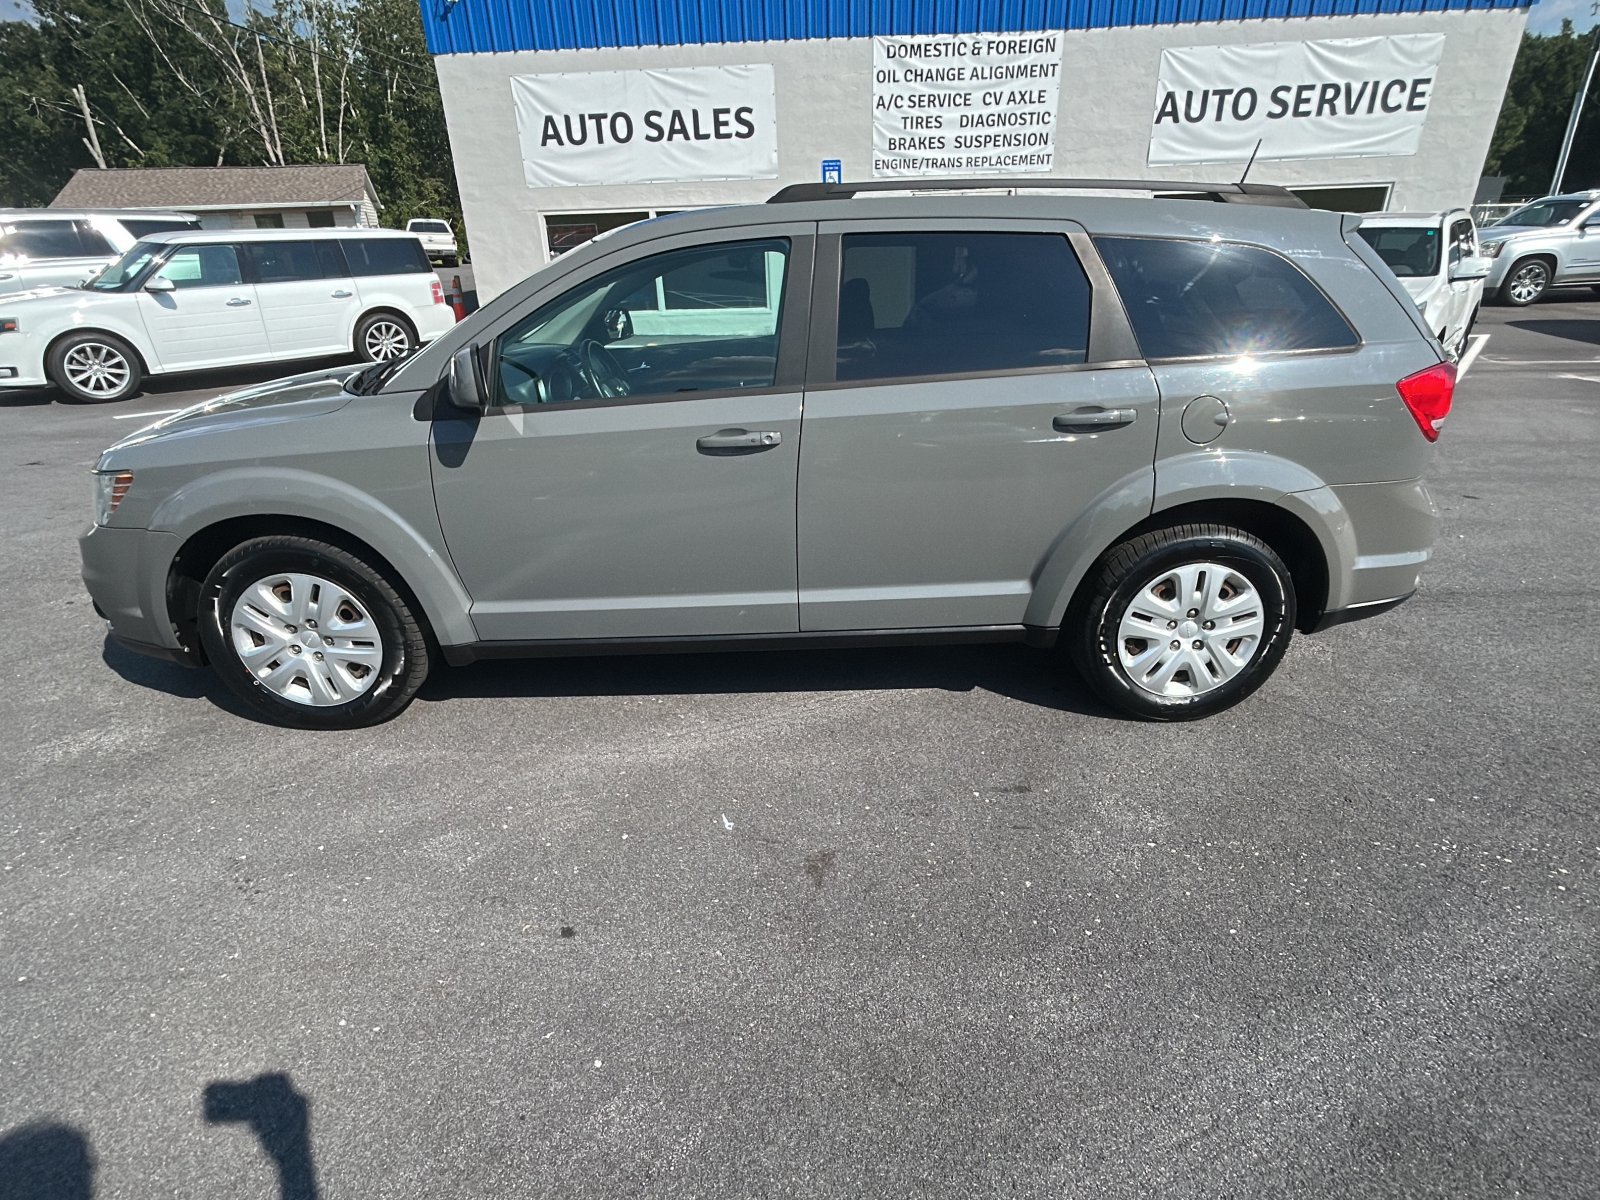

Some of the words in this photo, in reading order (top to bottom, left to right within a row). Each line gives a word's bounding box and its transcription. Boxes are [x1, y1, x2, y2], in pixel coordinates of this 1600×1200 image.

[886, 42, 967, 59] DOMESTIC
[971, 41, 983, 56] &
[986, 38, 1057, 56] FOREIGN
[876, 69, 900, 84] OIL
[904, 67, 966, 83] CHANGE
[970, 63, 1059, 81] ALIGNMENT
[876, 93, 904, 111] A/C
[907, 92, 972, 109] SERVICE
[982, 91, 1003, 106] CV
[1006, 90, 1047, 105] AXLE
[1154, 87, 1258, 125] AUTO
[1266, 77, 1432, 120] SERVICE
[541, 111, 634, 147] AUTO
[643, 106, 755, 142] SALES
[901, 115, 943, 130] TIRES
[959, 111, 1052, 128] DIAGNOSTIC
[888, 136, 946, 151] BRAKES
[954, 132, 1049, 149] SUSPENSION
[874, 157, 963, 171] ENGINE/TRANS
[965, 153, 1052, 168] REPLACEMENT
